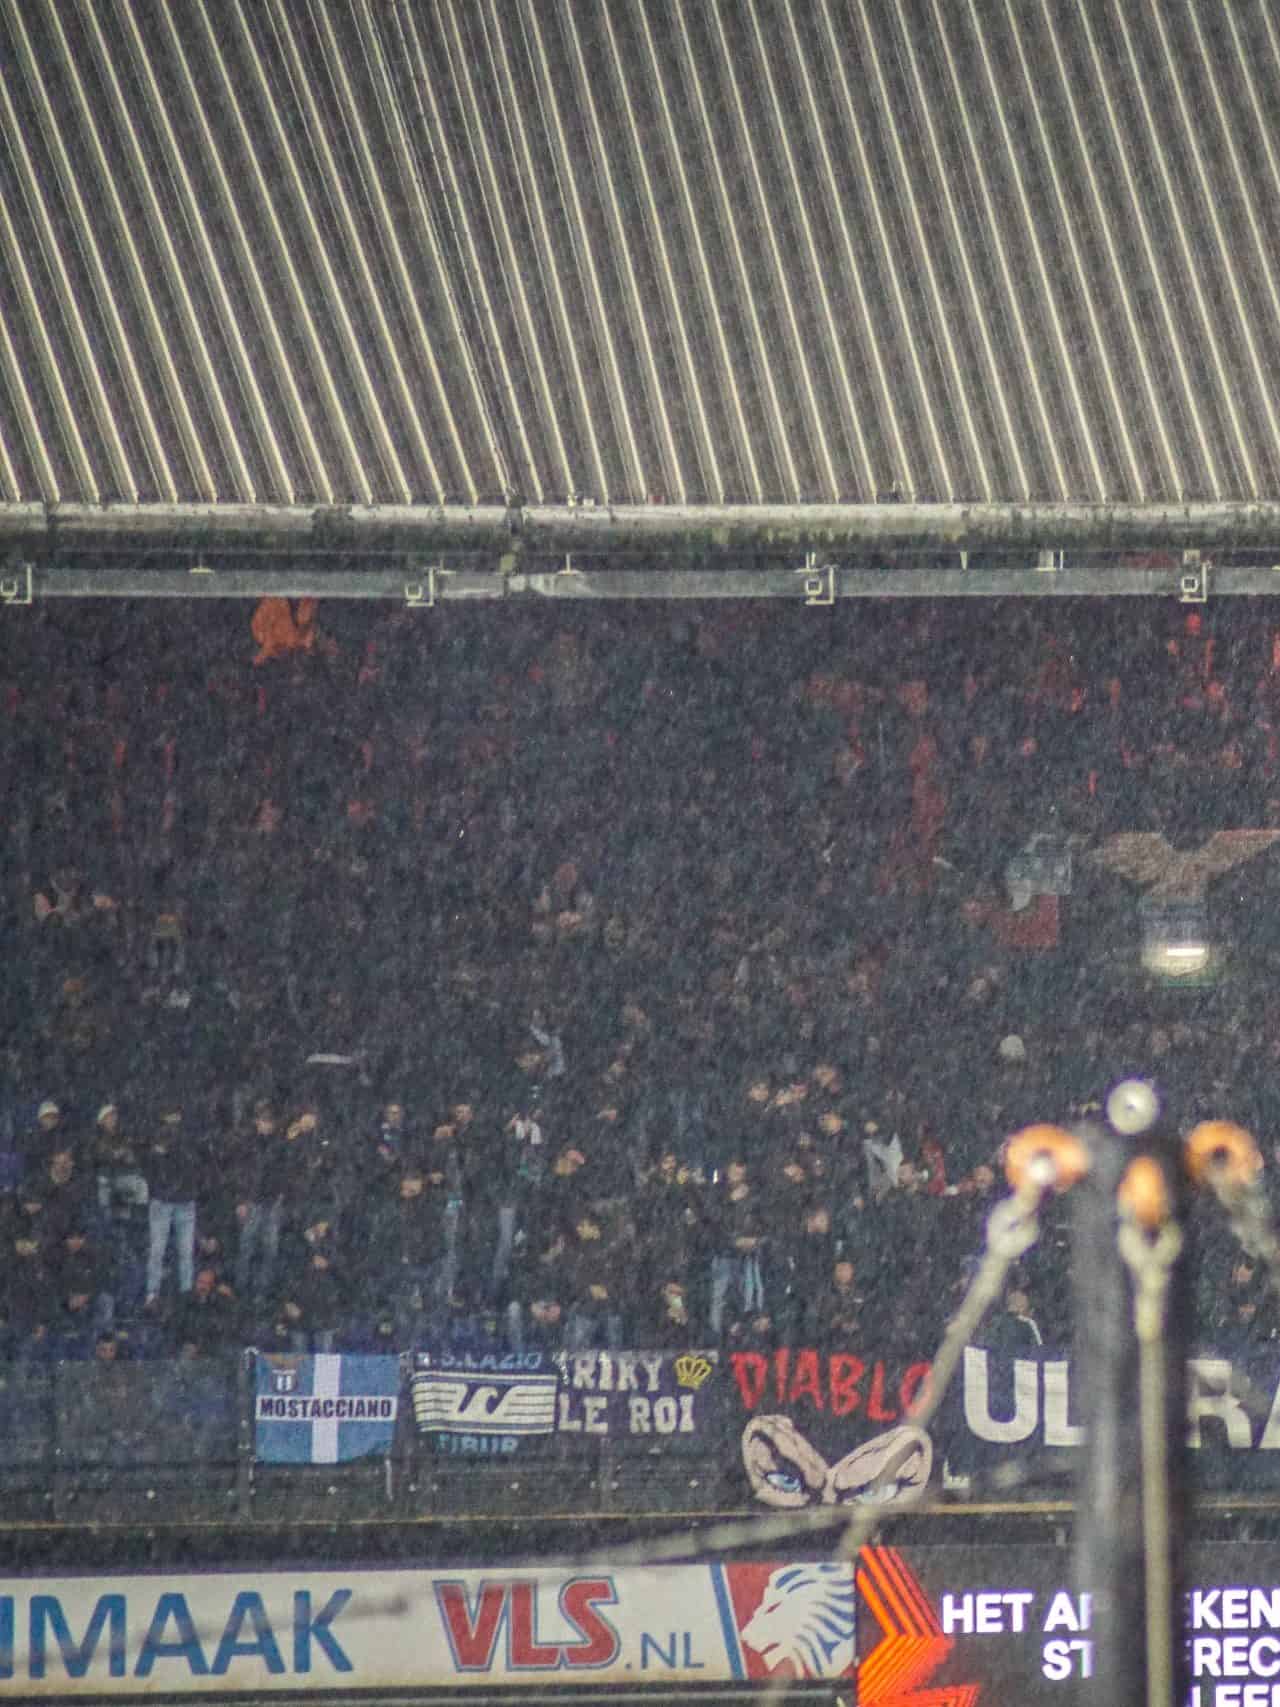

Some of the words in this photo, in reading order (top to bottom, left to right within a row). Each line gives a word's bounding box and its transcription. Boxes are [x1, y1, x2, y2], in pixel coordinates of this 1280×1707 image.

[730, 1346, 934, 1423] DIABLO
[259, 1398, 392, 1418] MOSTACCIANO
[558, 1393, 609, 1434] LE
[628, 1394, 695, 1434] ROI
[942, 1590, 1033, 1634] HET
